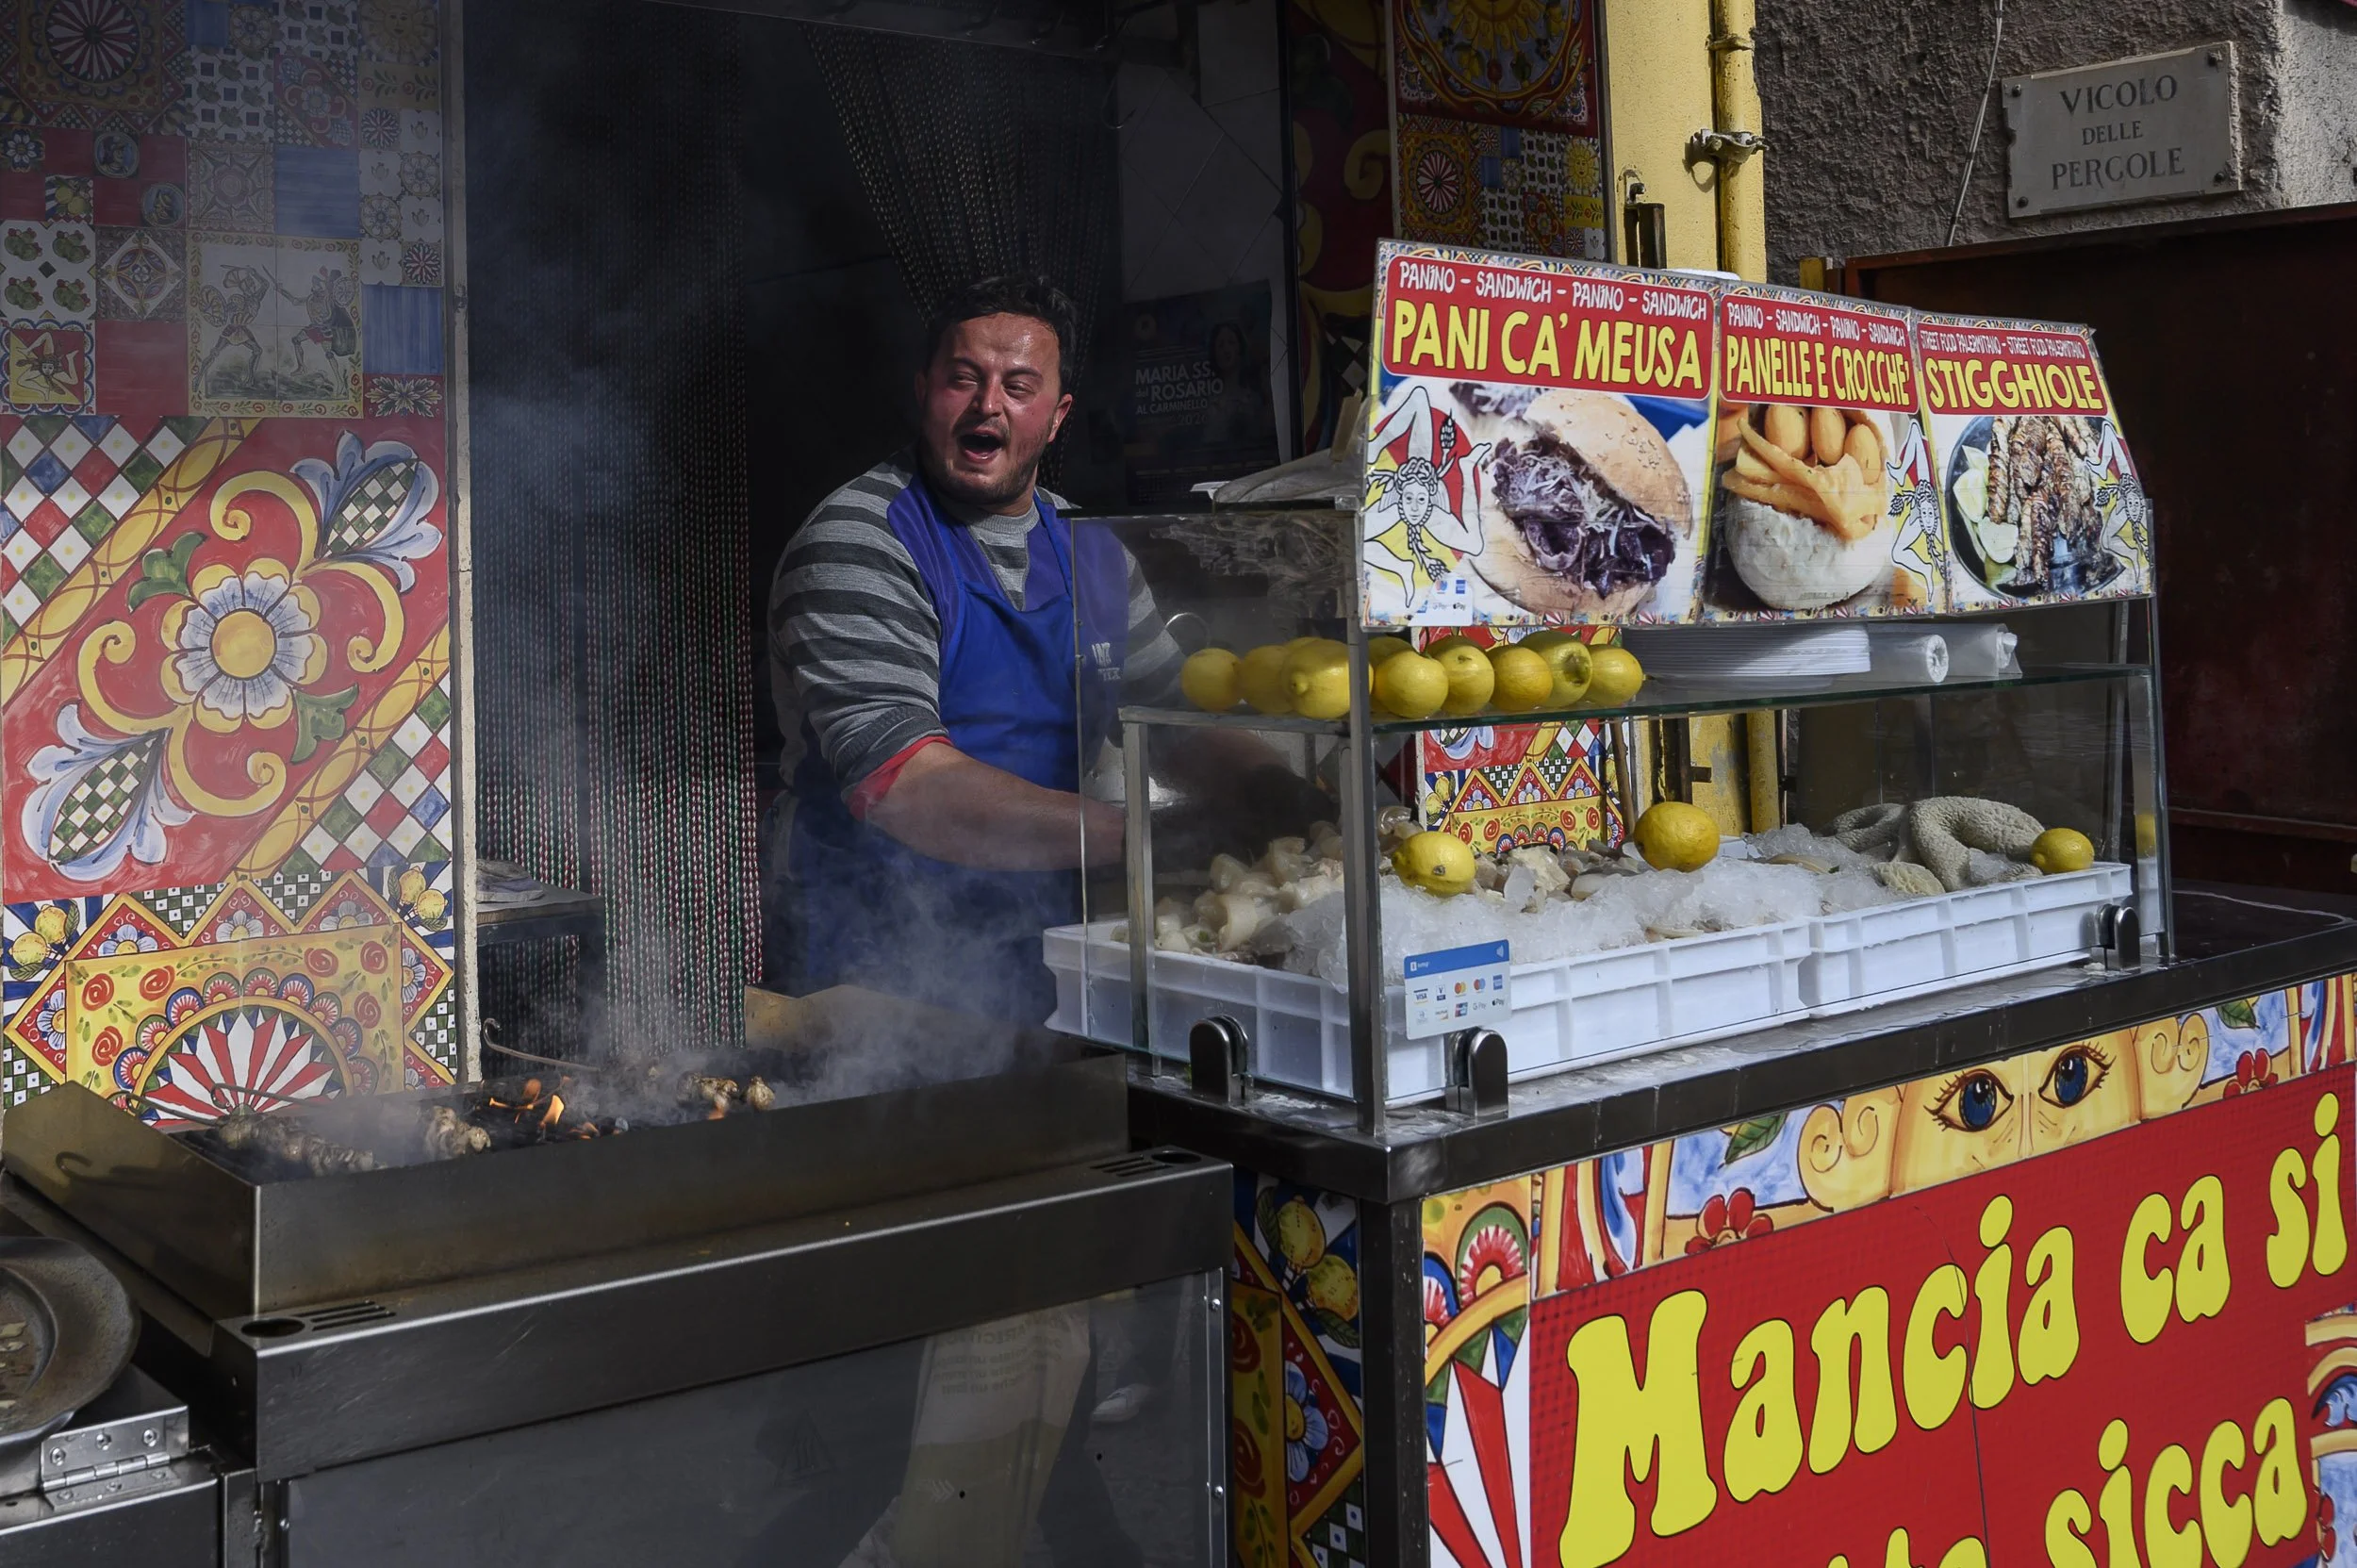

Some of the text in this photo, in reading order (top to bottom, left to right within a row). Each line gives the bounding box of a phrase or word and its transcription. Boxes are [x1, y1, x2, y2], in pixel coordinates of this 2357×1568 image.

[2060, 74, 2178, 115] VICOLO
[2081, 120, 2143, 146] DELLE
[1392, 299, 1490, 371] PANI
[1573, 318, 1703, 389] MEUSA
[1726, 335, 1813, 399] PANELLE
[1817, 342, 1830, 400] E
[1135, 364, 1189, 385] MARIA
[1150, 378, 1224, 403] ROSARIO
[1925, 357, 2104, 411] STIGGHIOLE
[1149, 398, 1209, 415] CARMINELLO
[1559, 1092, 2348, 1568] Mancia ca si
[2045, 1396, 2308, 1568] sicca
